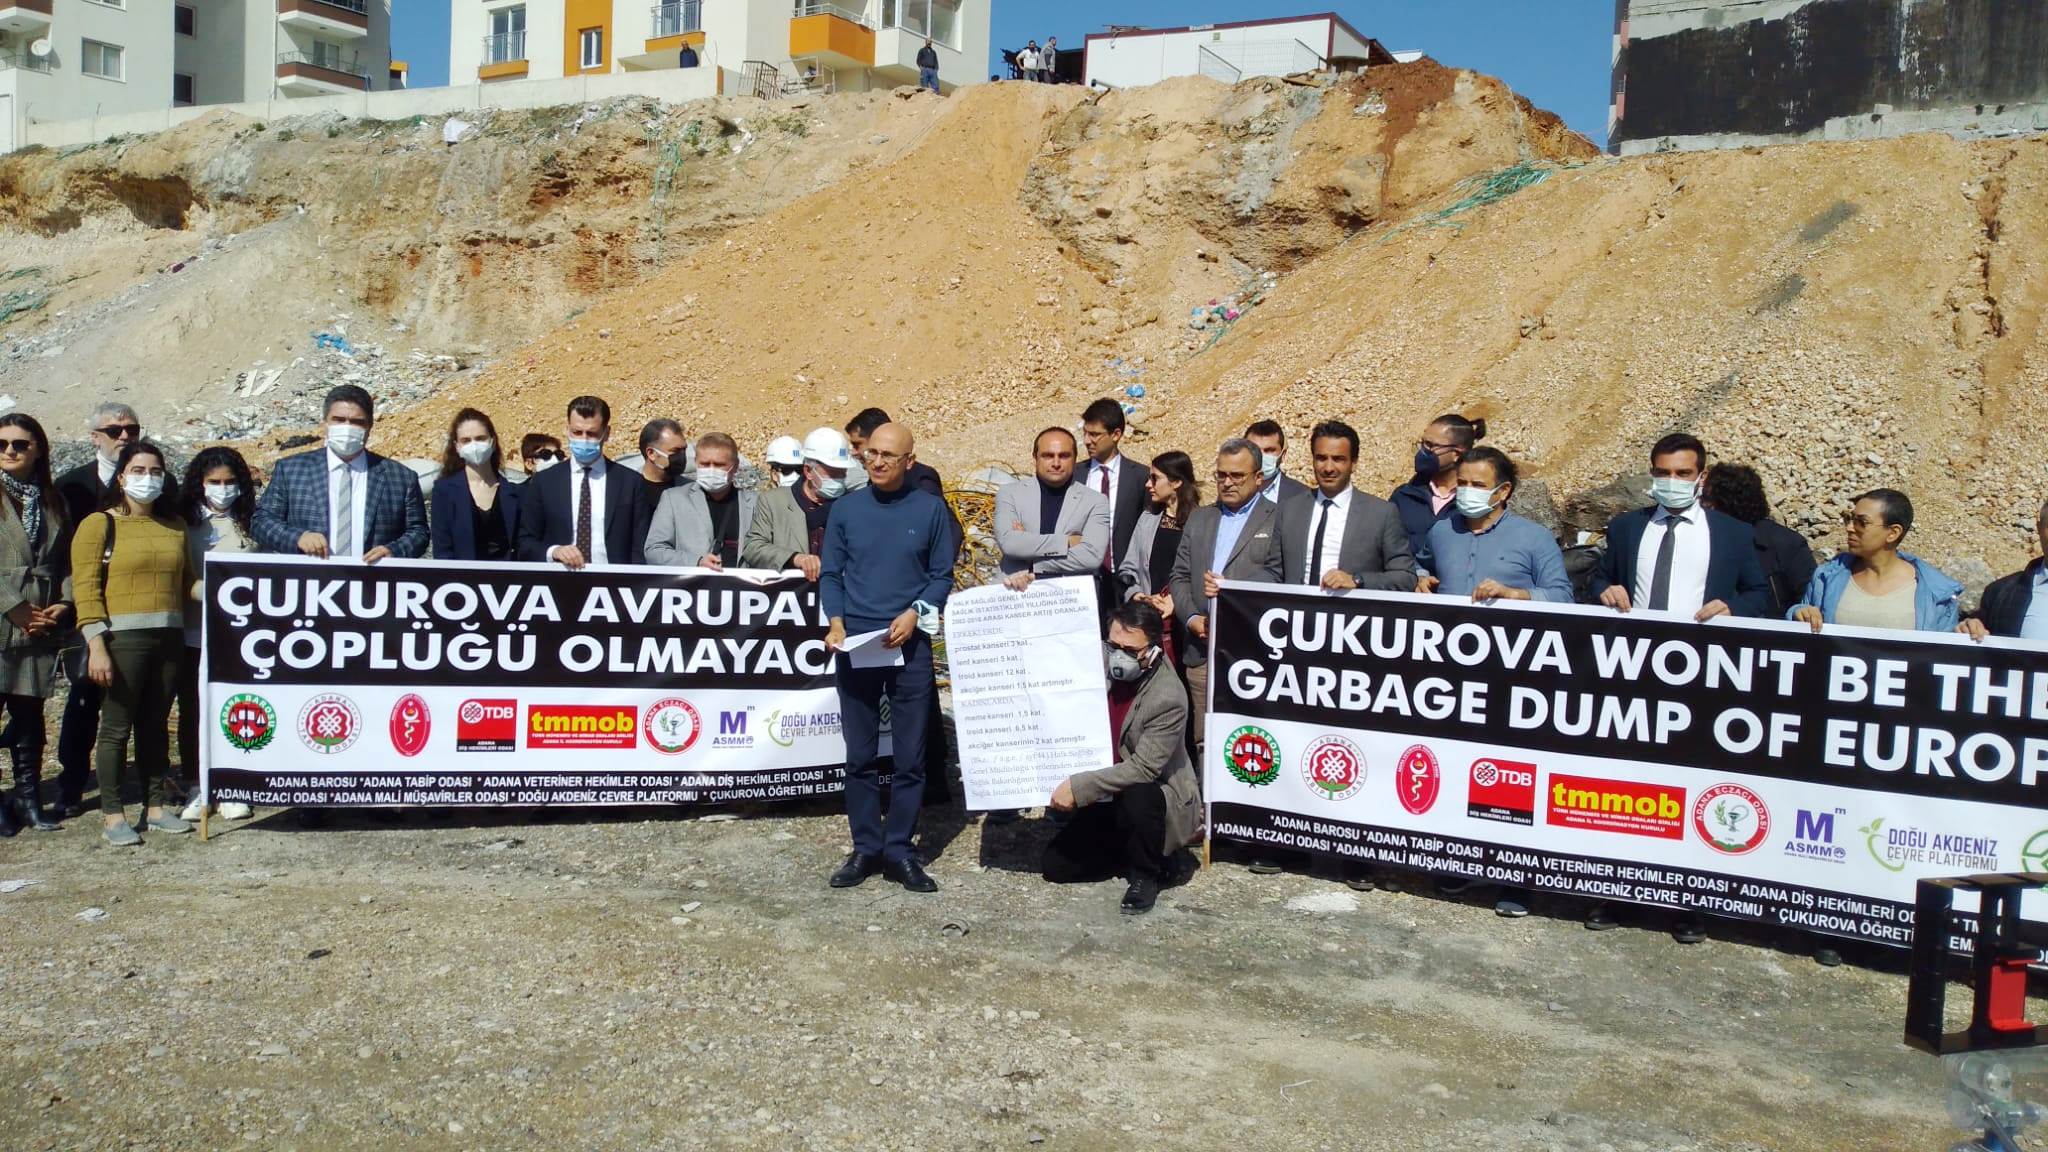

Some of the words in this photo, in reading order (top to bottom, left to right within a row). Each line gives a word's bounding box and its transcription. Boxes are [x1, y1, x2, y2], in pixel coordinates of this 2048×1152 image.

[217, 577, 560, 626] ÇUKUROVA
[240, 619, 537, 680] ÇÖPLÜĞÜ
[1258, 607, 1572, 674] ÇUKUROVA
[1592, 633, 1805, 696] WON'T
[1827, 655, 1907, 707] BE
[484, 706, 514, 719] TDB
[532, 711, 634, 732] tmmob
[781, 712, 806, 727] DOĞU
[1228, 659, 1488, 725] GARBAGE
[1509, 685, 1692, 744] DUMP
[1713, 707, 1801, 758] OF
[310, 777, 357, 788] BAROSU
[405, 774, 436, 788] TABİP
[438, 776, 472, 788] ODASI
[484, 776, 521, 787] ADANA
[524, 774, 582, 787] VETERİNER
[585, 774, 638, 787] HEKİMLER
[640, 776, 672, 786] ODASI
[681, 776, 715, 787] ADANA
[718, 773, 734, 788] DİŞ
[737, 770, 790, 786] HEKİMLERİ
[793, 770, 824, 783] ODASI
[1499, 770, 1532, 786] TDB
[253, 792, 291, 803] ECZACI
[293, 792, 327, 803] ODASI
[375, 790, 401, 803] MALİ
[404, 790, 473, 805] MÜŞAVİRLER
[475, 791, 509, 803] ODASI
[518, 789, 549, 803] DOĞU
[551, 790, 597, 802] AKDENİZ
[599, 791, 634, 804] ÇEVRE
[637, 790, 698, 801] PLATFORMU
[710, 788, 766, 803] ÇUKUROVA
[768, 783, 813, 797] ÖĞRETİM
[1552, 782, 1680, 818] tmmob
[1888, 827, 1928, 849] DOĞU
[1932, 832, 1998, 857] AKDENİZ
[1313, 822, 1360, 840] BAROSU
[1410, 837, 1444, 852] TABİP
[1446, 842, 1483, 858] ODASI
[1496, 850, 1539, 868] ADANA
[1542, 857, 1614, 877] VETERİNER
[1617, 866, 1684, 886] HEKİMLER
[1687, 875, 1729, 892] ODASI
[1740, 883, 1788, 902] ADANA
[1792, 889, 1814, 910] DİŞ
[1817, 895, 1896, 920] HEKİMLERİ
[1928, 850, 1998, 872] PLATFORMU
[1256, 828, 1294, 845] ECZACI
[1296, 835, 1330, 851] ODASI
[1378, 849, 1406, 864] MALİ
[1409, 852, 1483, 876] MÜŞAVİRLER
[1486, 866, 1525, 883] ODASI
[1535, 873, 1573, 890] DOĞU
[1574, 882, 1631, 897] AKDENİZ
[1634, 886, 1679, 903] ÇEVRE
[1682, 893, 1763, 917] PLATFORMU
[1779, 908, 1856, 933] ÇUKUROVA
